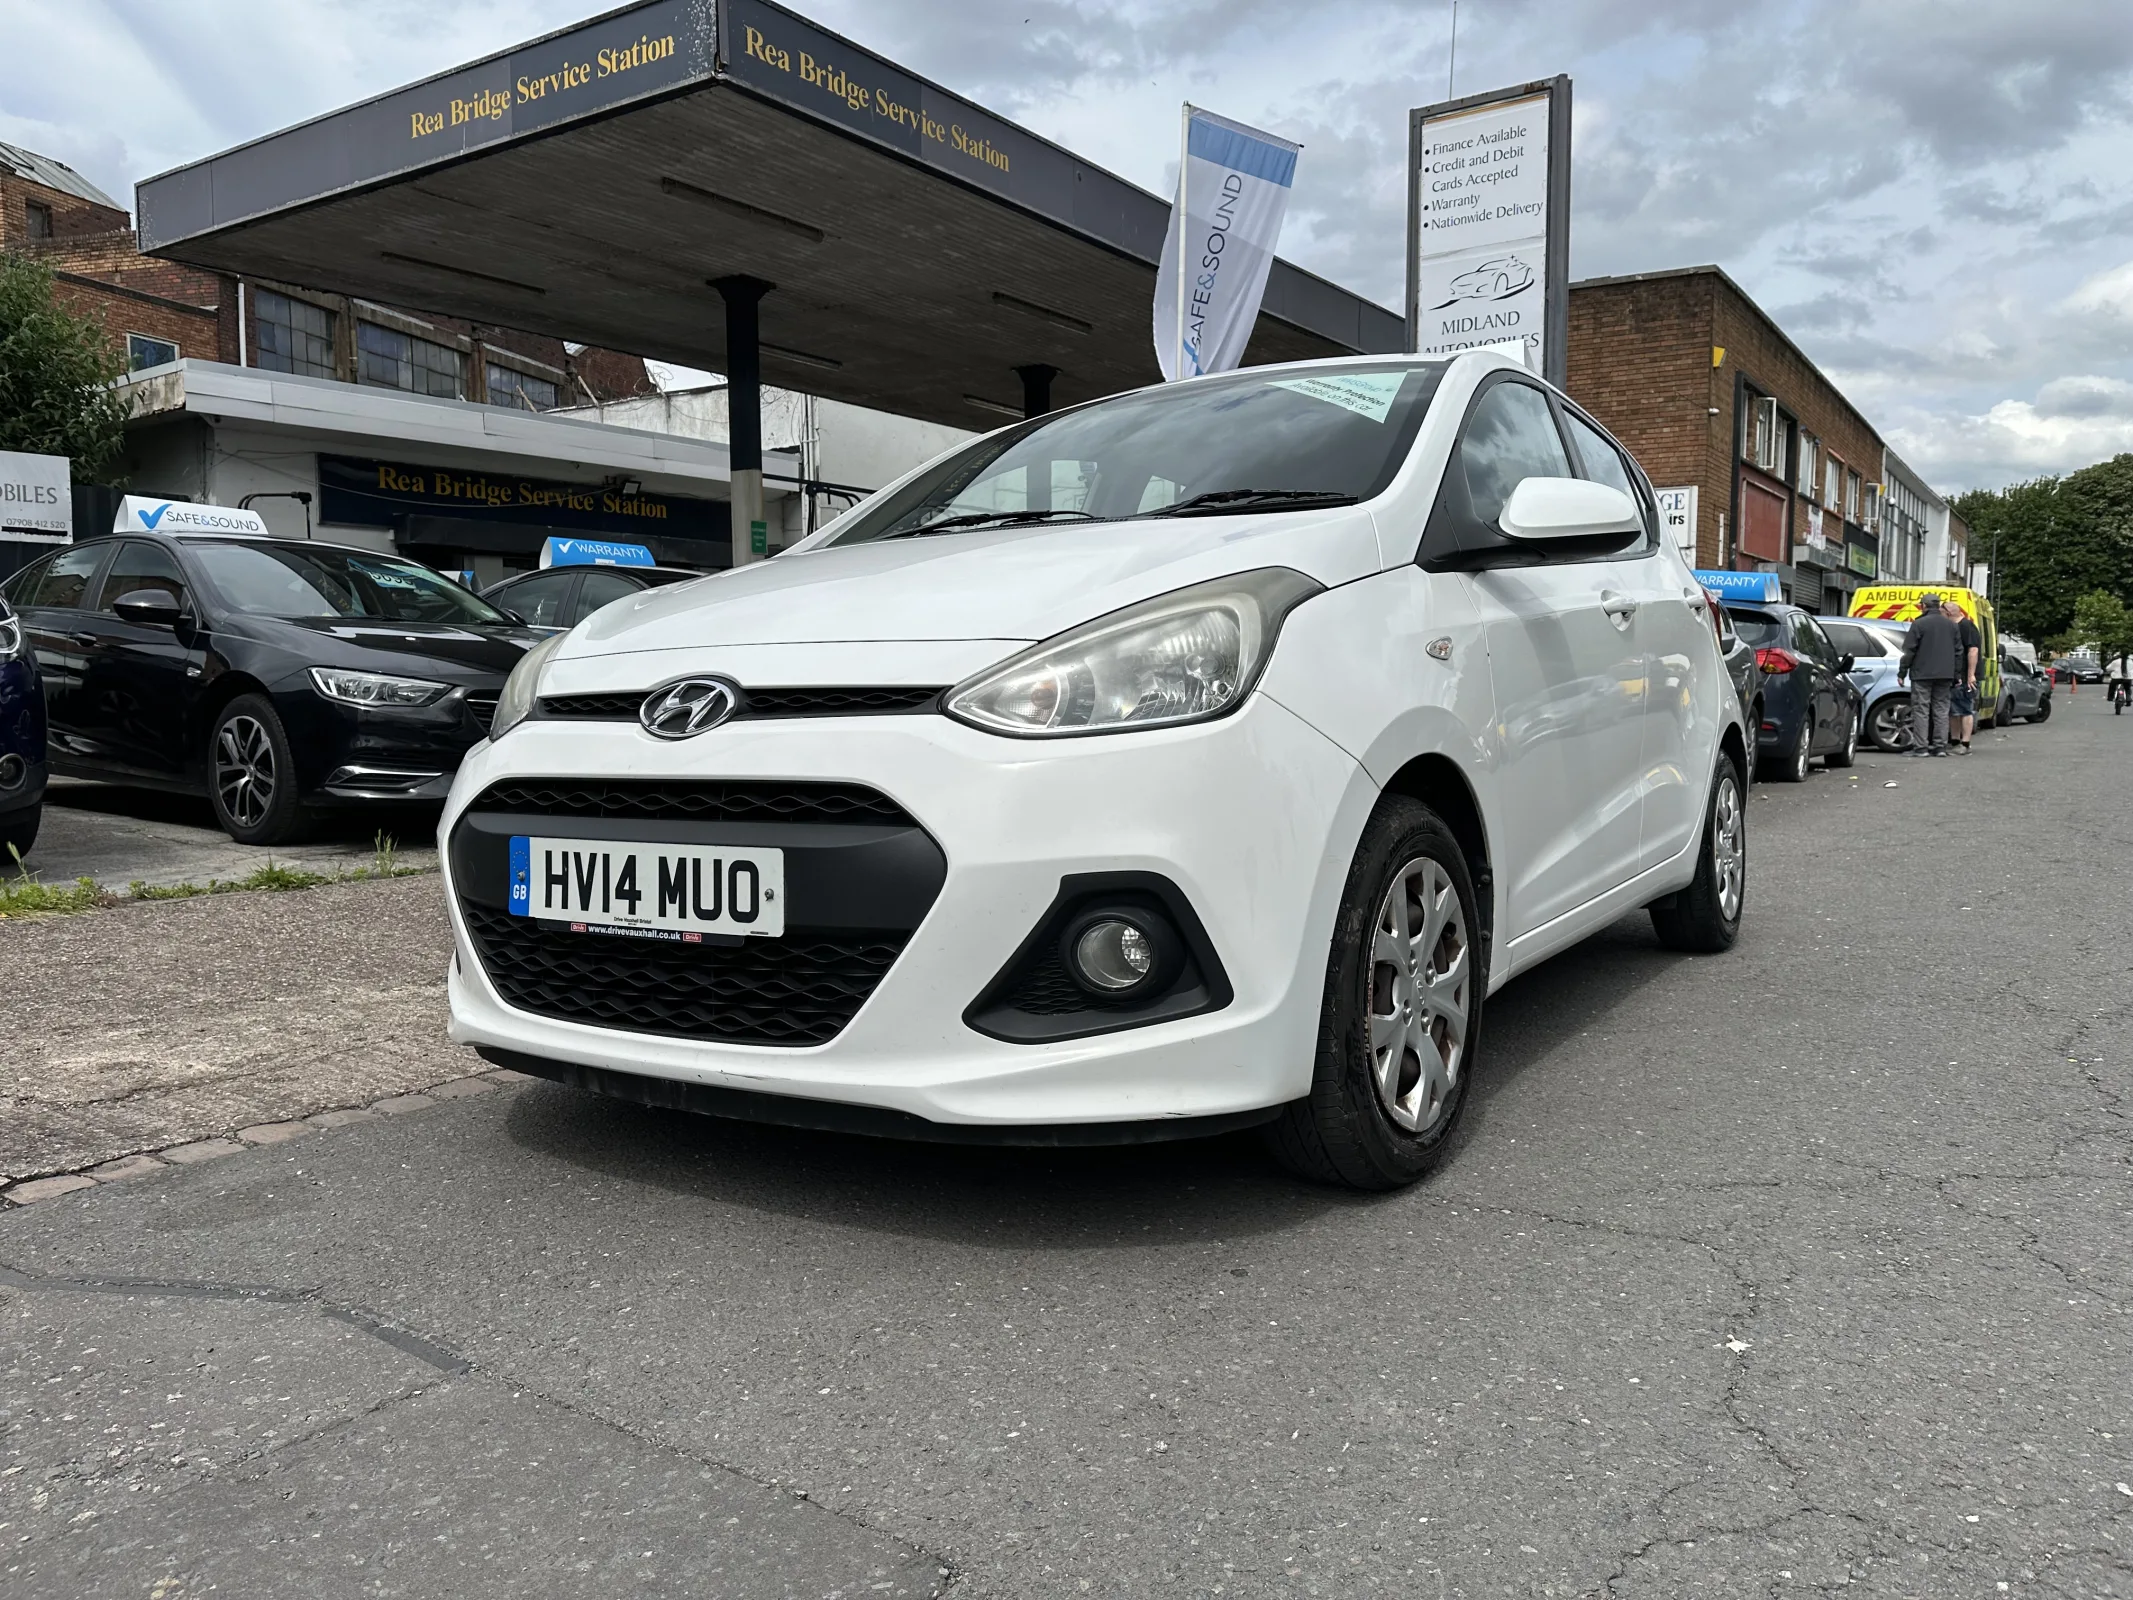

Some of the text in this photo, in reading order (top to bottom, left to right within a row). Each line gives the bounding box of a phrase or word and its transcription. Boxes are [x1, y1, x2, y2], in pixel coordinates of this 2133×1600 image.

[411, 35, 675, 139] Rea Bridge Service Station
[744, 25, 1010, 172] Rea Bridge Service Station
[1433, 125, 1527, 155] Finance Available
[1432, 145, 1524, 174] Credit and Debit
[1432, 165, 1518, 193] Cards Accepted
[1431, 194, 1481, 212] Warranty
[1431, 202, 1543, 230] Nationwide Delivery
[1441, 311, 1520, 335] MIDLAND
[1306, 379, 1386, 407] Warranty Protection
[0, 483, 58, 505] BILES
[378, 466, 668, 519] Rea Bridge Service Station
[6, 517, 66, 529] 07908 412 520
[166, 511, 259, 532] SAFE&SOUND
[574, 542, 645, 559] WARRANTY
[513, 884, 527, 900] GB
[545, 850, 760, 924] HV14 MUO
[588, 925, 681, 941] www.drivevauxhall.co.uk
